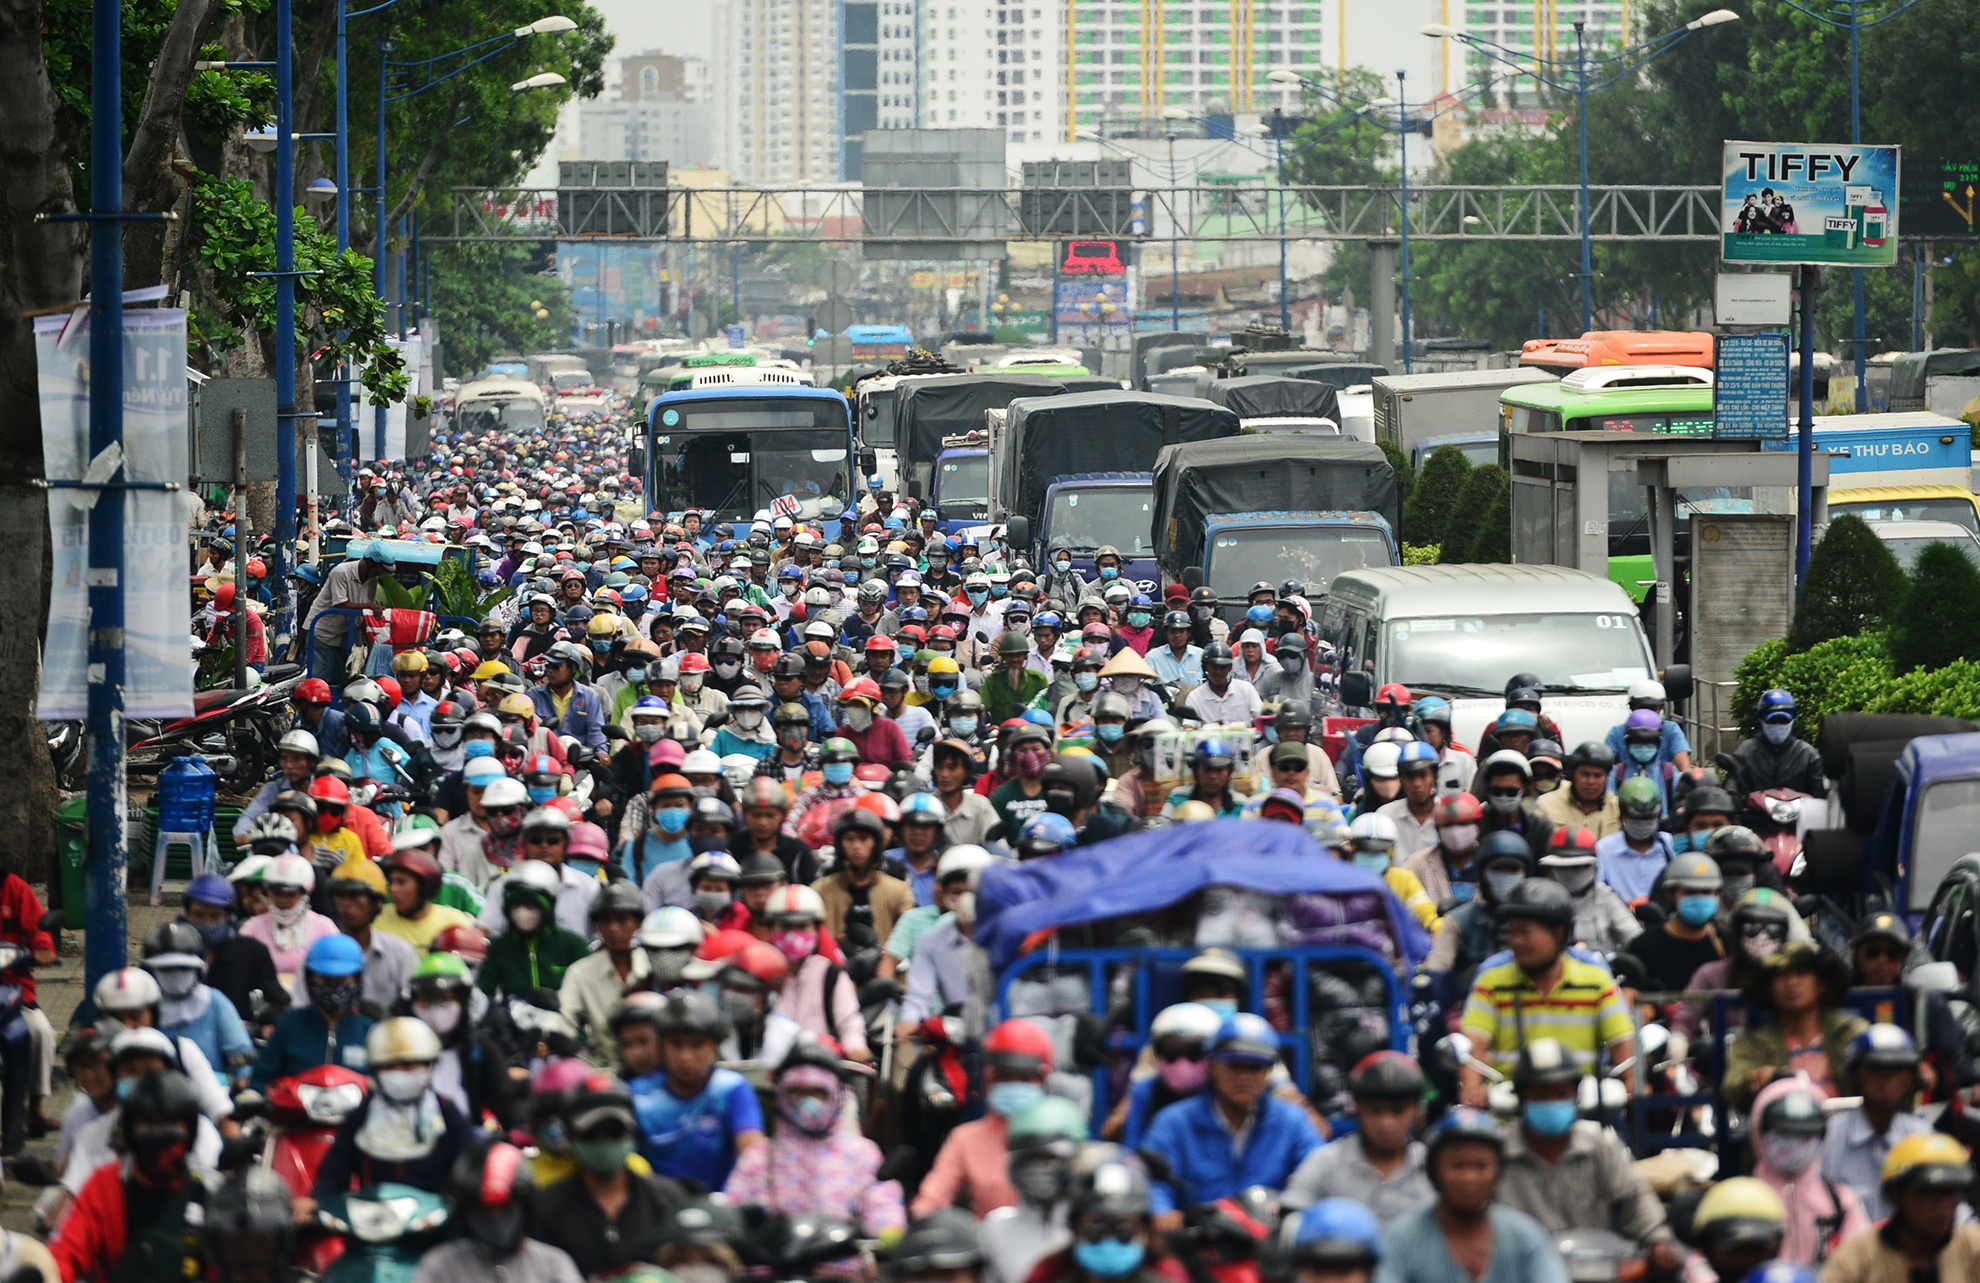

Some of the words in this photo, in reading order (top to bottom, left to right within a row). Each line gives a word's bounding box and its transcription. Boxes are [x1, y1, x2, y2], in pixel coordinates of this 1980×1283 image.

[1739, 152, 1860, 182] TIFFY
[1828, 219, 1856, 229] TIFFY
[1854, 444, 1888, 457] THƯ
[1892, 441, 1930, 456] BÁO
[771, 495, 796, 516] 104
[1596, 615, 1628, 630] 01
